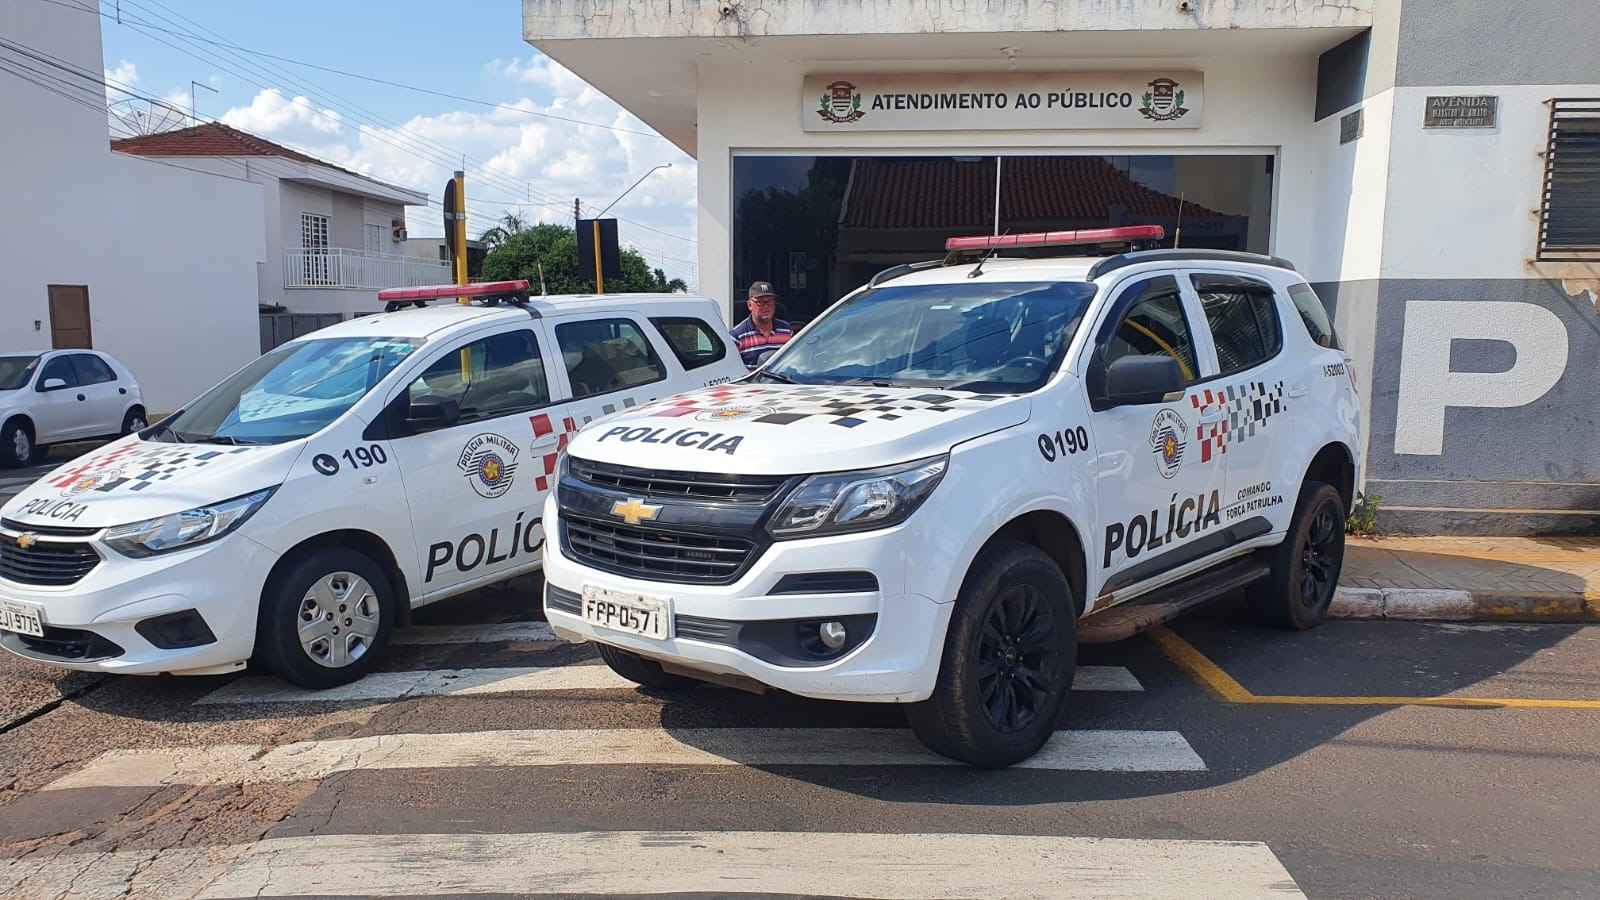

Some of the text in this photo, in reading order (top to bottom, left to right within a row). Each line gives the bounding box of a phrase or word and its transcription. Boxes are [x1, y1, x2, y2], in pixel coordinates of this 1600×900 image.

[871, 88, 1133, 110] ATENDIMENTO AO PÚBLICO
[1432, 97, 1488, 107] AVENIDA
[1394, 300, 1569, 456] P
[1166, 411, 1186, 434] MILITAR
[486, 436, 516, 456] MILITAR
[597, 426, 745, 455] POLÍCIA
[1054, 425, 1089, 457] 190
[342, 444, 388, 470] 190
[1237, 480, 1272, 500] COMANDO
[1226, 495, 1283, 521] FORÇA PATRULHA
[1103, 488, 1221, 569] POLÍCIA
[424, 511, 546, 583] POLÍC
